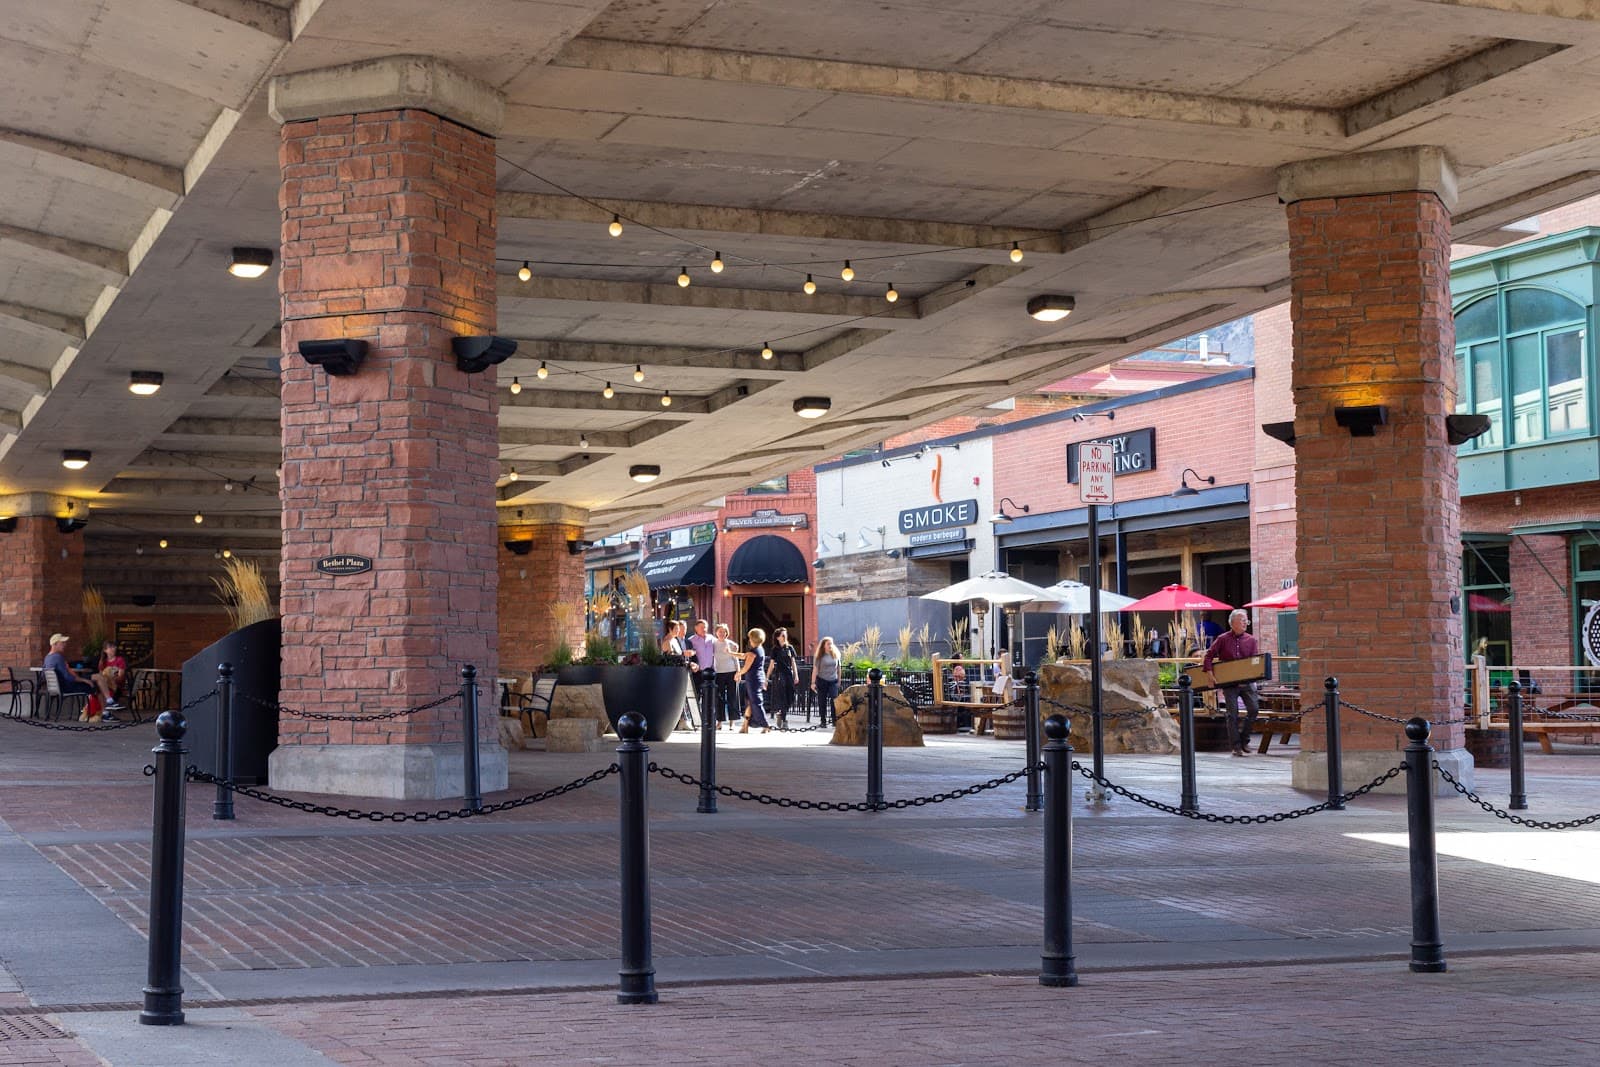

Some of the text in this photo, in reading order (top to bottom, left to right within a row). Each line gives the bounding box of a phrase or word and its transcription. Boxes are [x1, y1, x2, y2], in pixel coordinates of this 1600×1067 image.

[1091, 448, 1102, 460] NO
[1082, 461, 1111, 473] PARKING
[1090, 475, 1104, 483] ANY
[1090, 485, 1105, 494] TIME
[904, 504, 968, 528] SMOKE
[912, 534, 932, 542] modern
[323, 558, 364, 567] Bethel Plaza
[1280, 578, 1294, 590] 701
